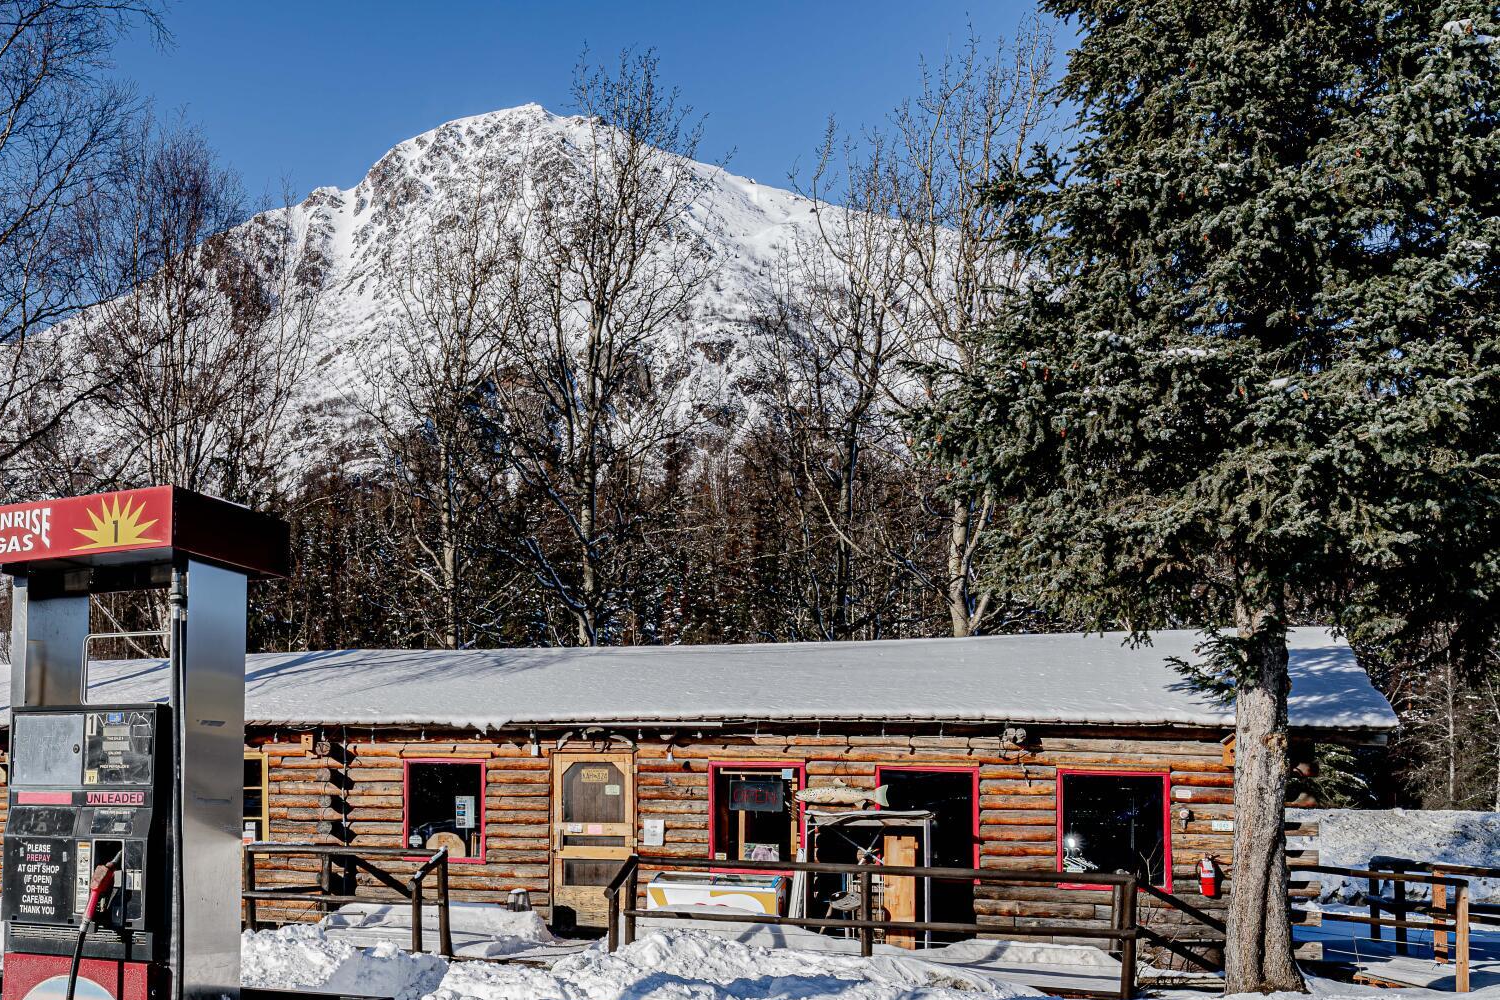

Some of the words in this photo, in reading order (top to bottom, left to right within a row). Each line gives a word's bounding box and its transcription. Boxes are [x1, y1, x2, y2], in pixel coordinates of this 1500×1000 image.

[113, 520, 119, 544] 1
[90, 715, 95, 734] 1
[87, 793, 144, 804] UNLEADED
[27, 844, 51, 853] PLEASE
[26, 853, 51, 862] PREPAY
[17, 864, 26, 872] AT
[27, 864, 40, 873] GIFT
[42, 865, 60, 873] SHOP
[24, 874, 32, 884] (IF
[33, 875, 53, 885] OPEN)
[37, 885, 49, 894] THE
[22, 894, 53, 904] CAFE/BAR
[20, 905, 40, 914] THANK
[41, 906, 55, 915] YOU
